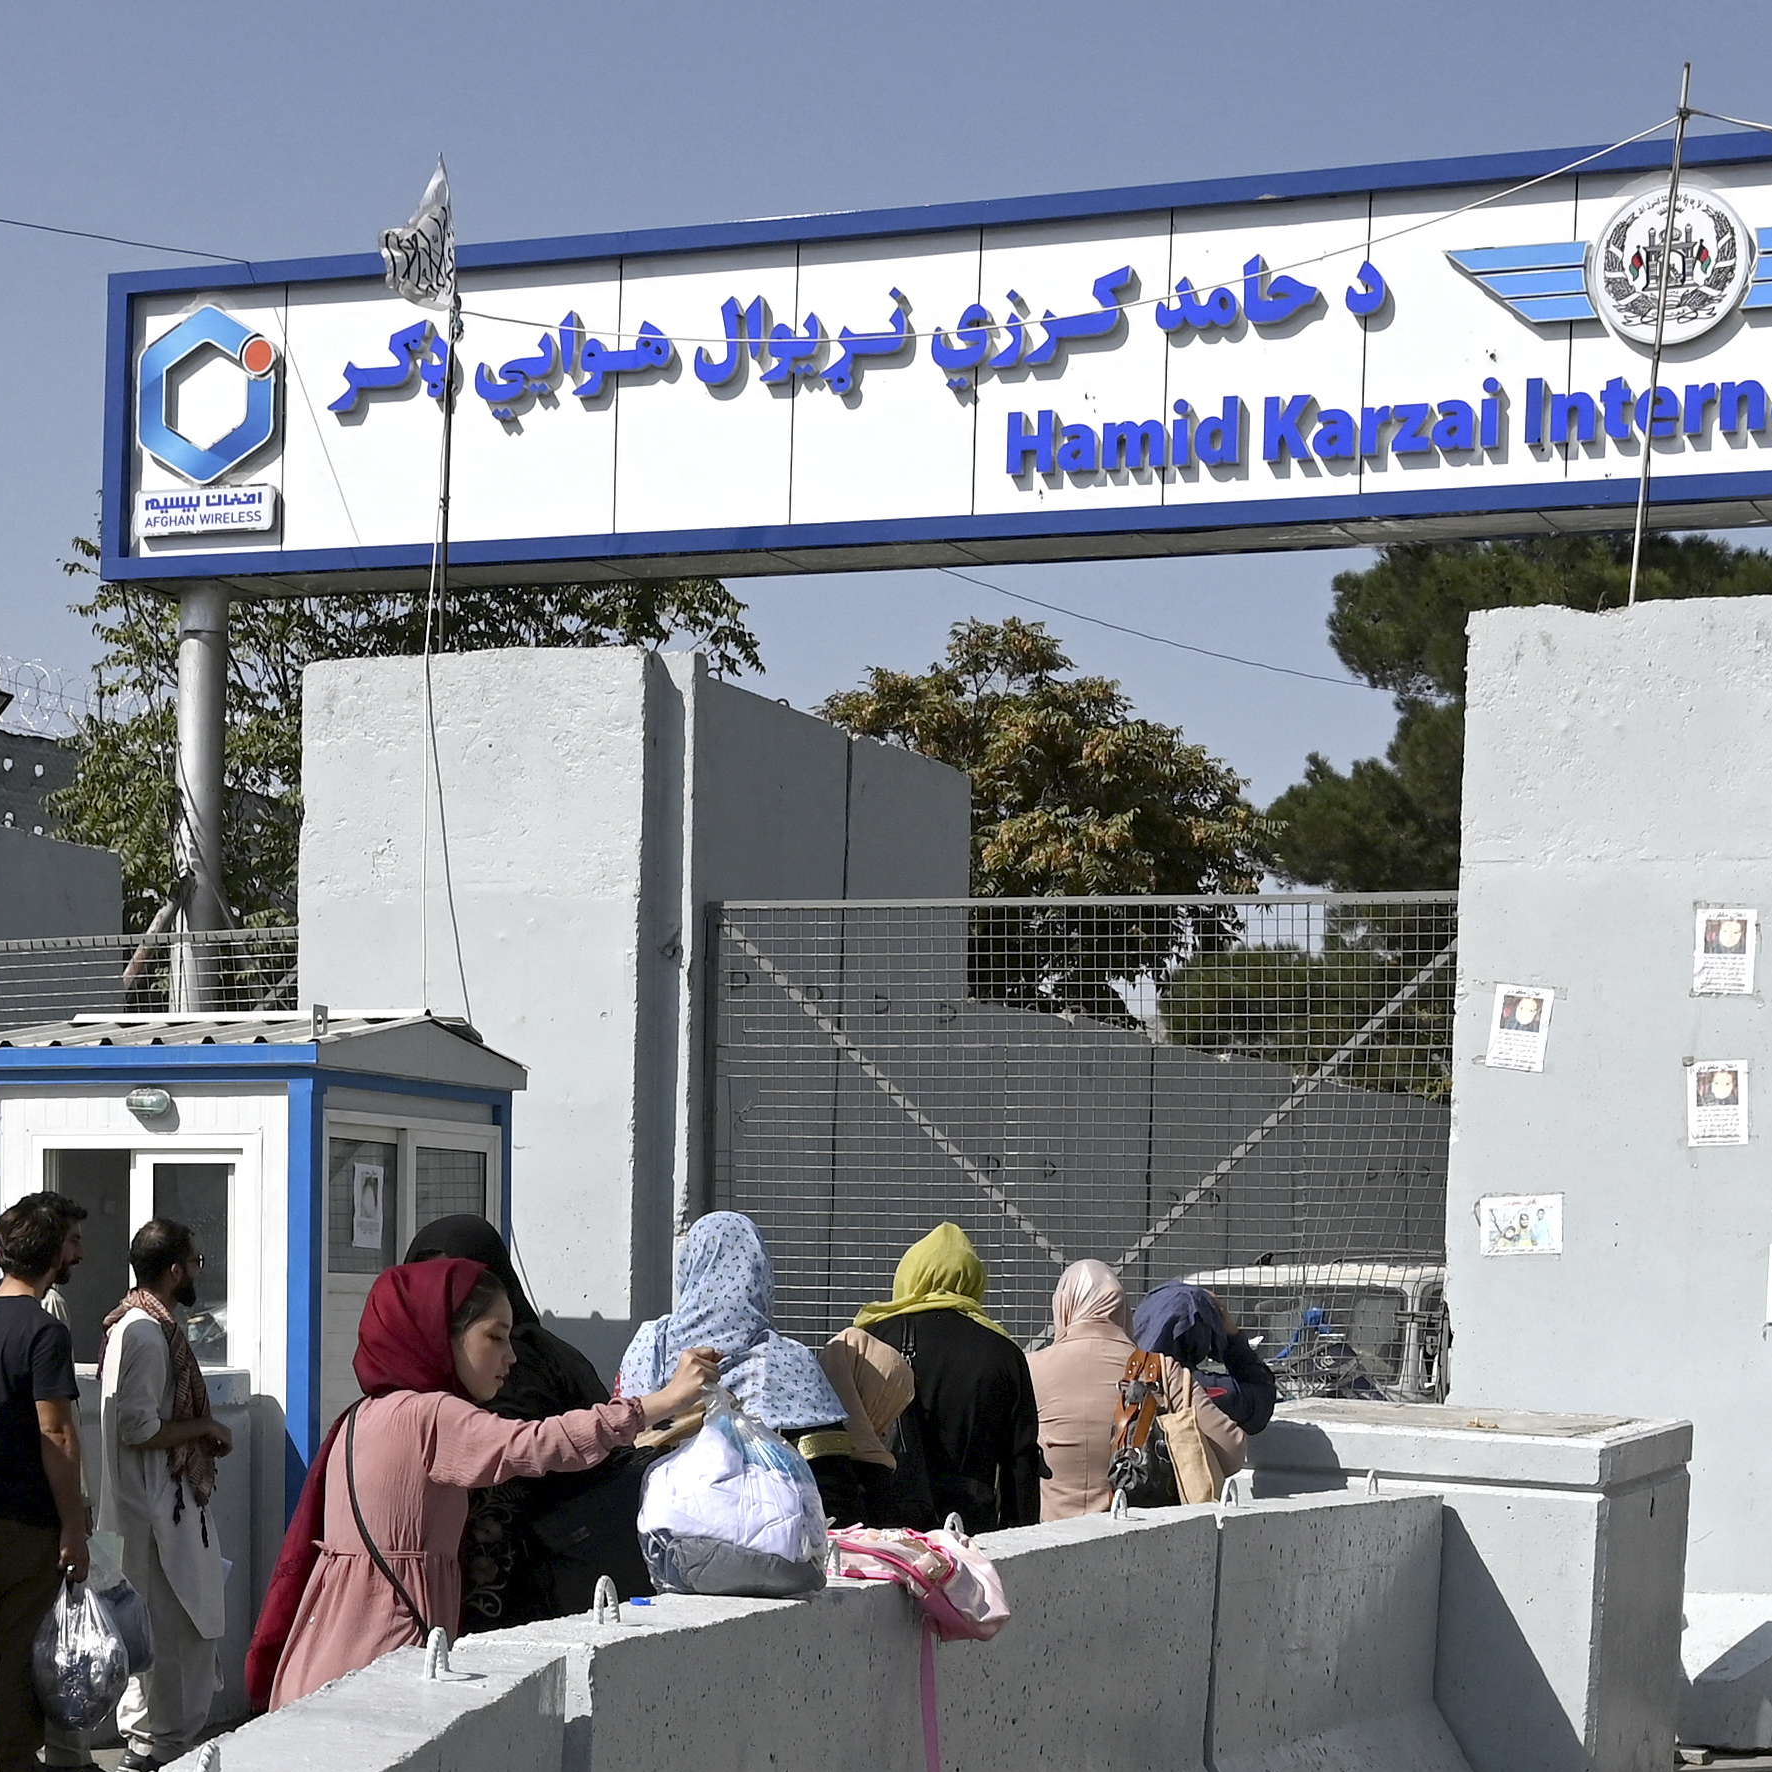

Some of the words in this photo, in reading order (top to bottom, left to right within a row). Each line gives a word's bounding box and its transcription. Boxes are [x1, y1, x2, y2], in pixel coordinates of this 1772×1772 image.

[1155, 254, 1319, 332] حامد
[1345, 260, 1387, 315] د
[693, 287, 908, 394] نړیوال
[1006, 394, 1241, 475] Hamid
[1262, 376, 1500, 462] Karzai
[144, 514, 195, 529] AFGHAN
[199, 510, 262, 525] WIRELESS
[145, 495, 201, 514] بیسیم
[205, 491, 263, 507] افغان
